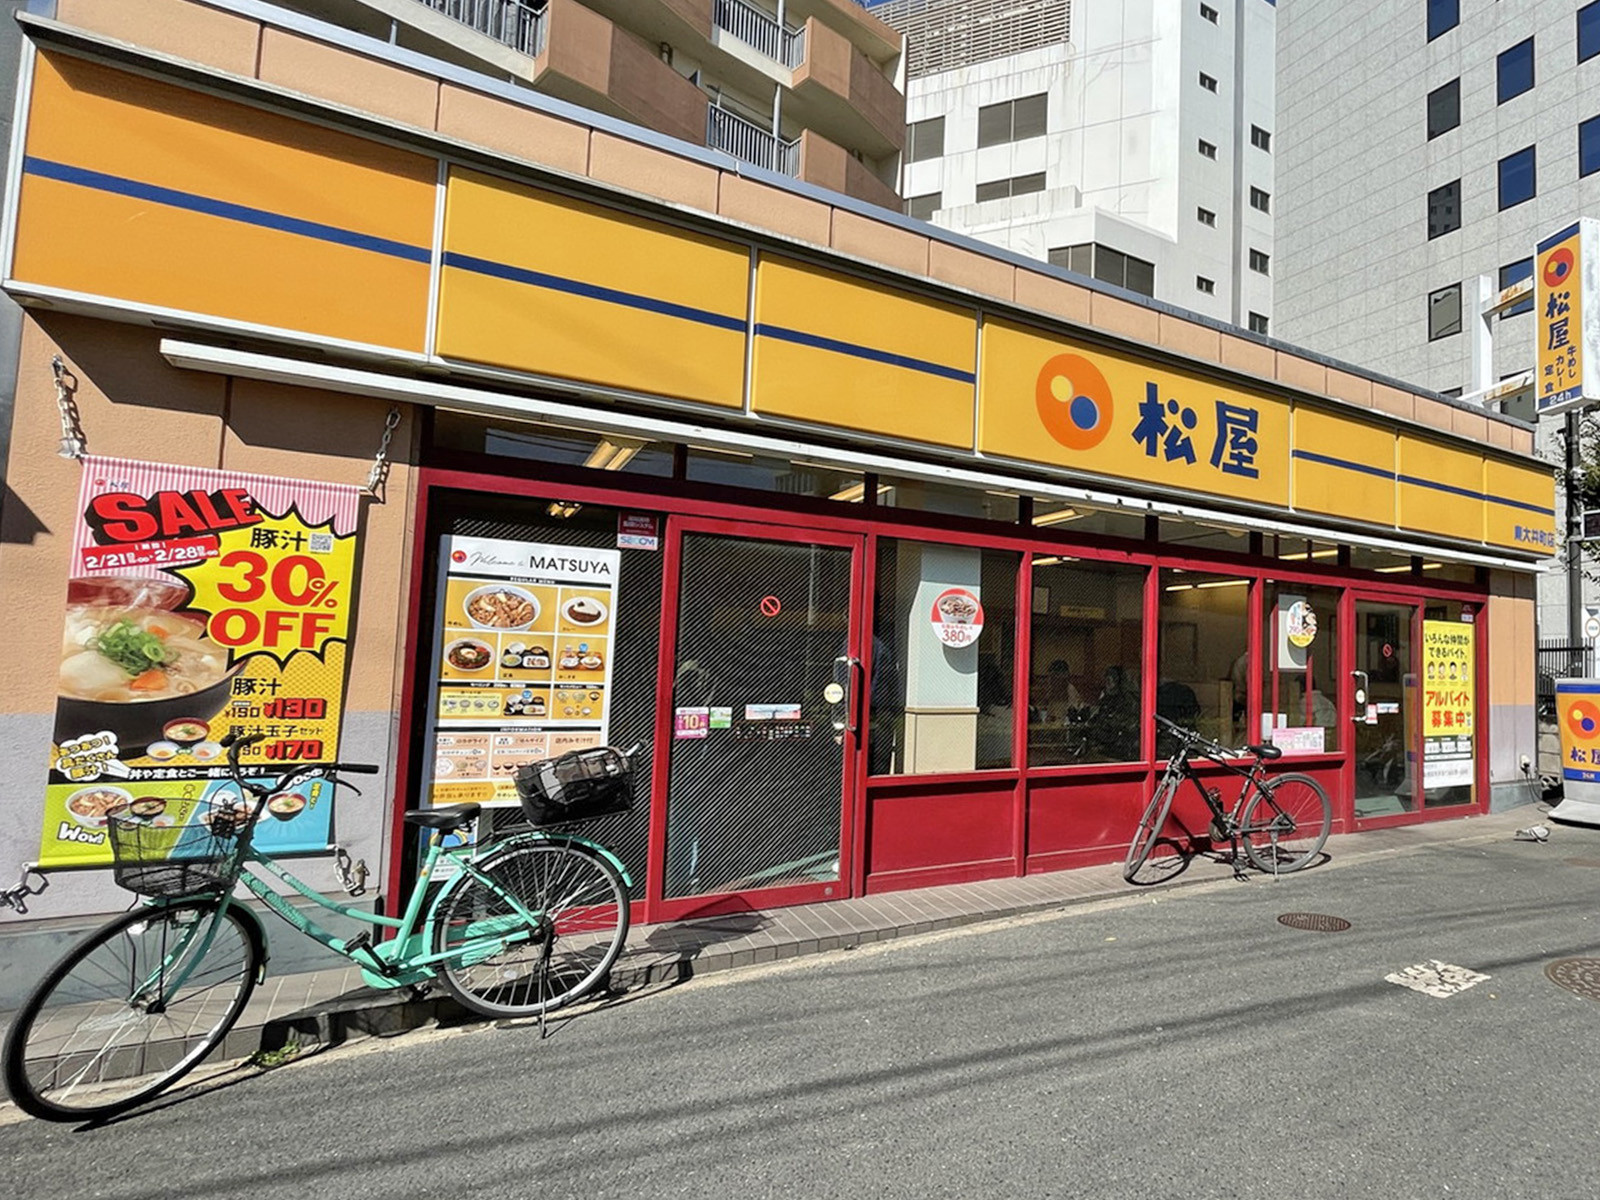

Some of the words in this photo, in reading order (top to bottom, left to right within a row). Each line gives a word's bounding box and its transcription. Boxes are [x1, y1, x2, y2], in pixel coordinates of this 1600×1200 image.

[1545, 291, 1570, 350] 松屋
[1555, 355, 1564, 387] カレー
[1567, 345, 1577, 378] 牛めし
[1544, 364, 1554, 393] 定食
[1549, 391, 1571, 406] 24h
[1132, 381, 1259, 479] 松屋
[88, 488, 265, 544] SALE
[250, 528, 308, 552] 豚汁
[470, 551, 516, 567] Welcome
[529, 556, 611, 575] MATSUYA
[218, 550, 338, 608] 30%
[210, 609, 336, 649] OFF
[1425, 633, 1470, 646] いろんな仲間が
[232, 677, 282, 696] 豚汁
[1426, 690, 1470, 707] アルバイト
[263, 698, 327, 719] ¥130
[1431, 710, 1465, 728] 募集中
[265, 740, 323, 760] ¥170
[128, 767, 265, 780] 丼や定食とご一緒にうぞ！
